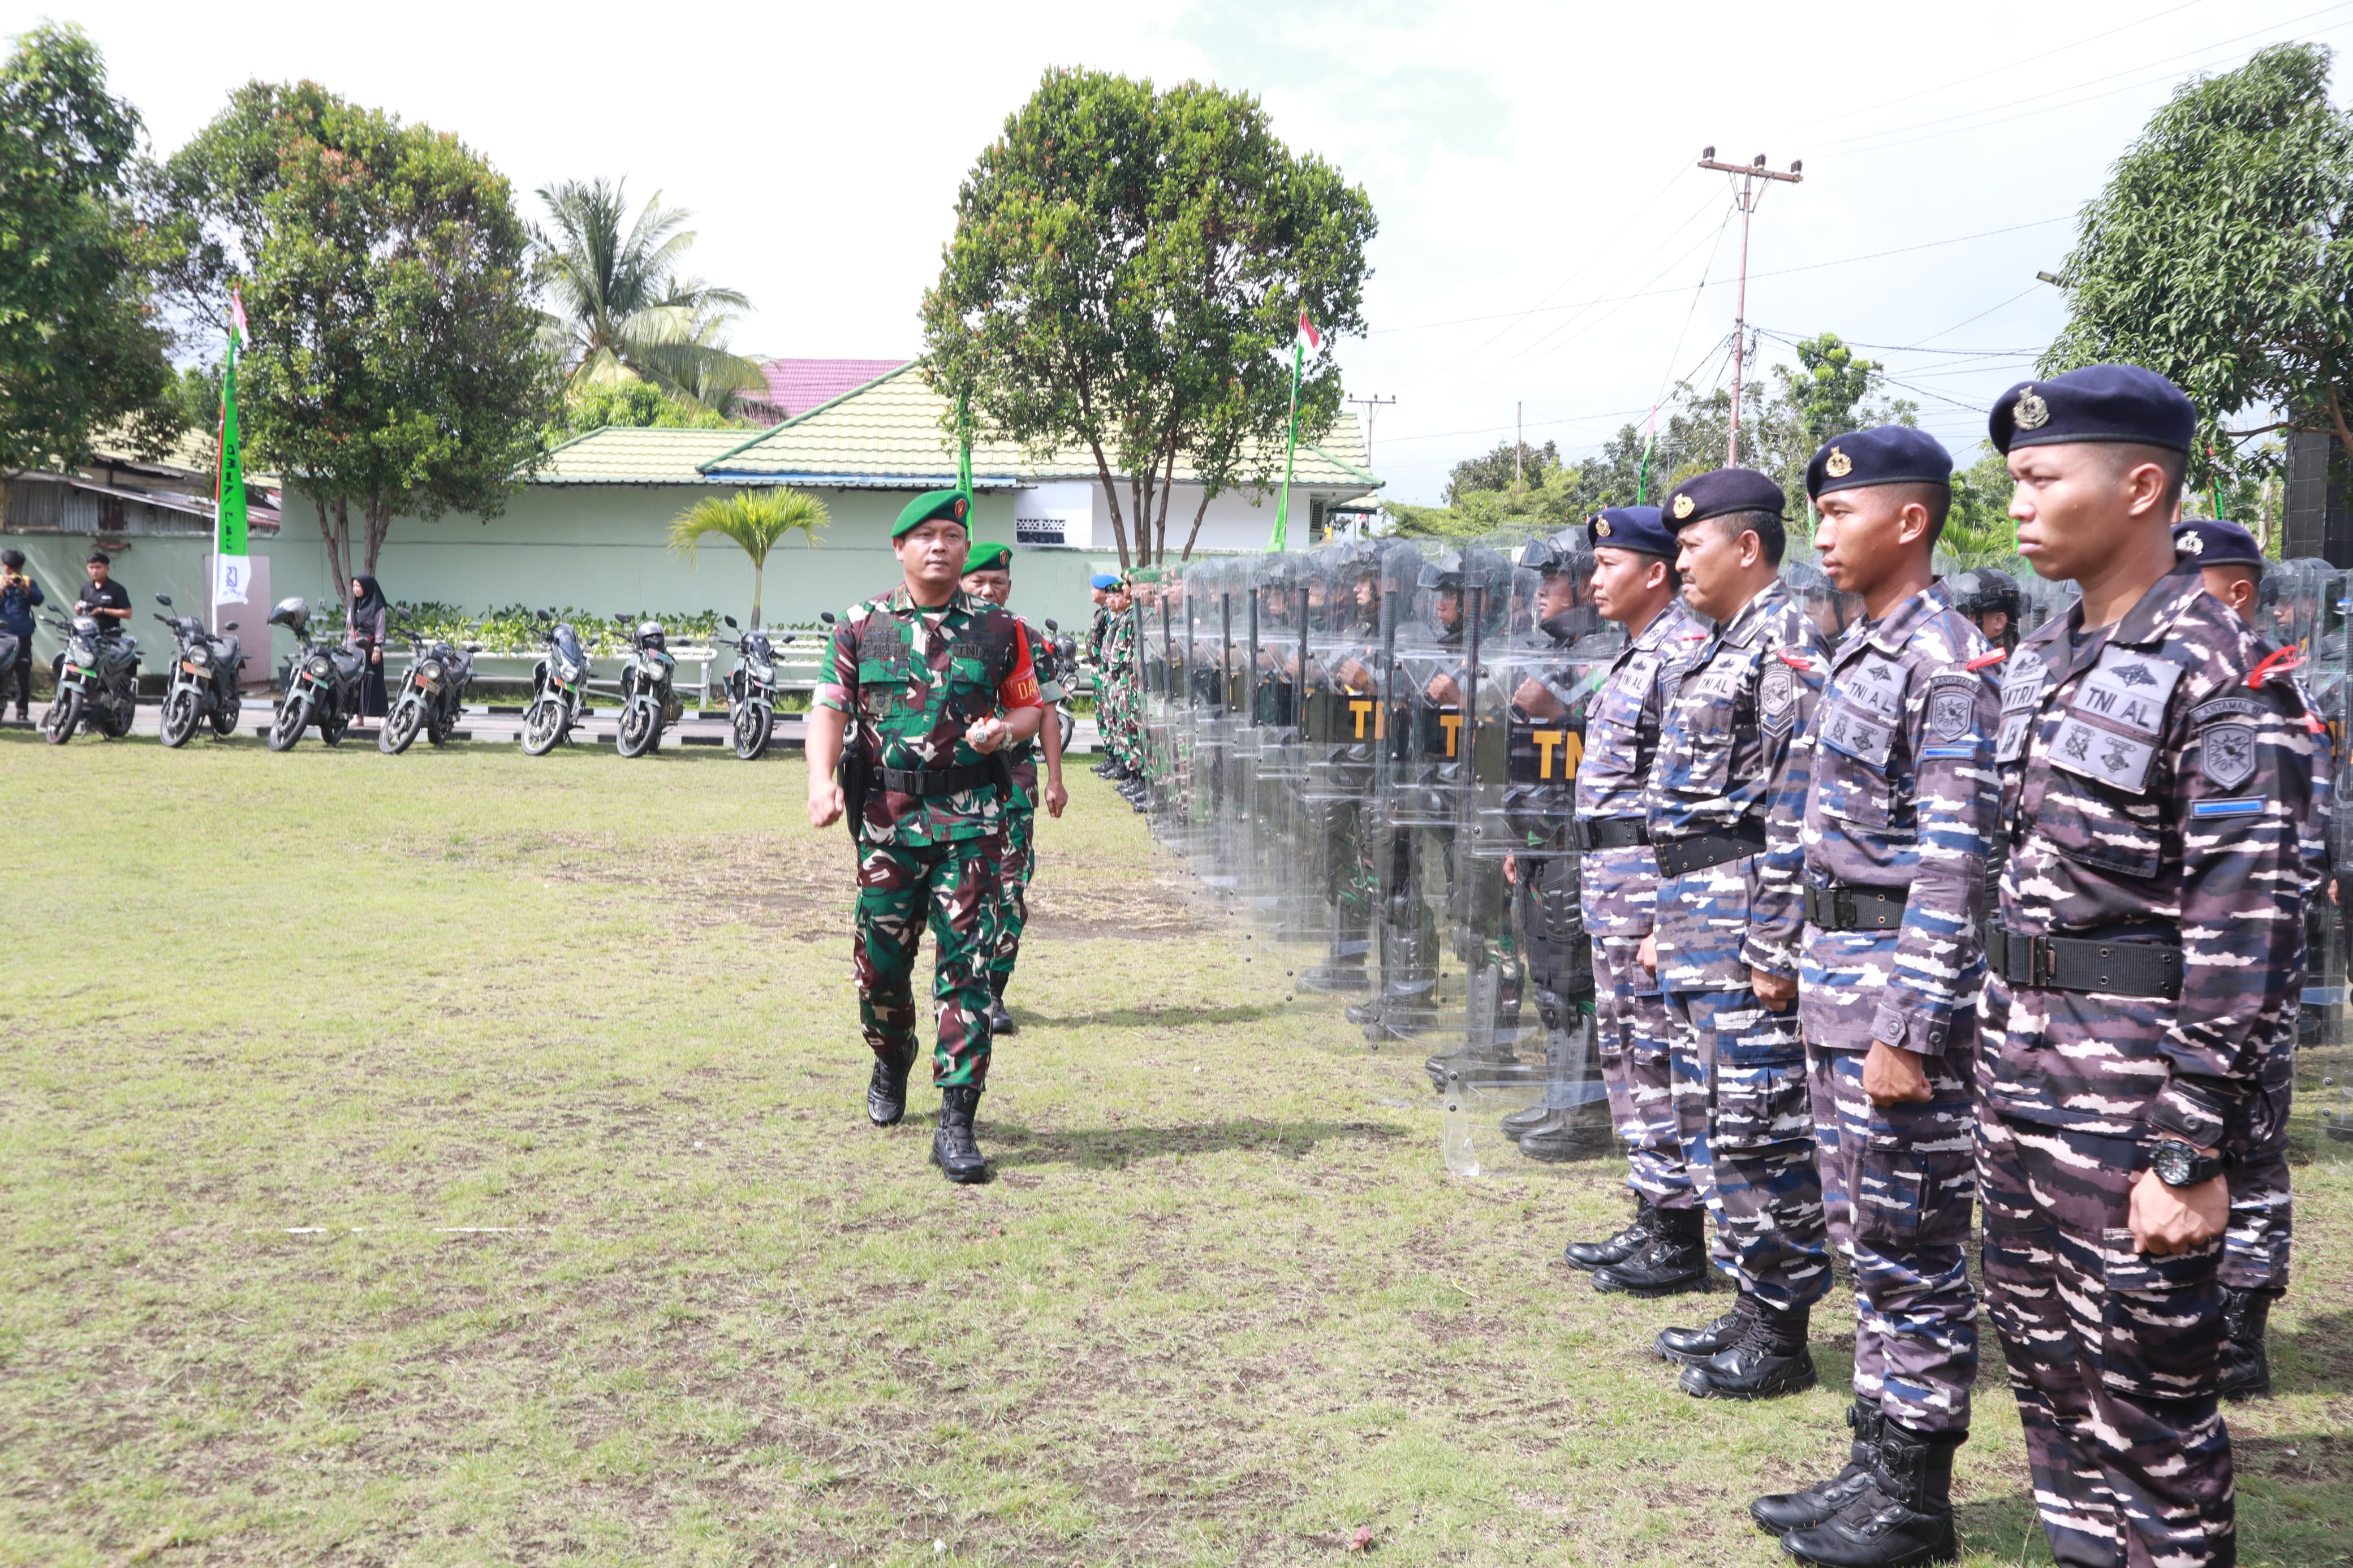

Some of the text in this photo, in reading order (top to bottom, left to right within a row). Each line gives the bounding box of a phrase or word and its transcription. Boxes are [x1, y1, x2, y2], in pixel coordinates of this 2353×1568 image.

[959, 645, 979, 656] TNI
[1622, 674, 1643, 690] TNI AL
[1699, 678, 1727, 694] TNI AL
[1849, 682, 1868, 701] TNI
[1868, 692, 1891, 712] AL
[2085, 686, 2150, 728] TNI AL
[2195, 701, 2248, 718] LANTAMAL
